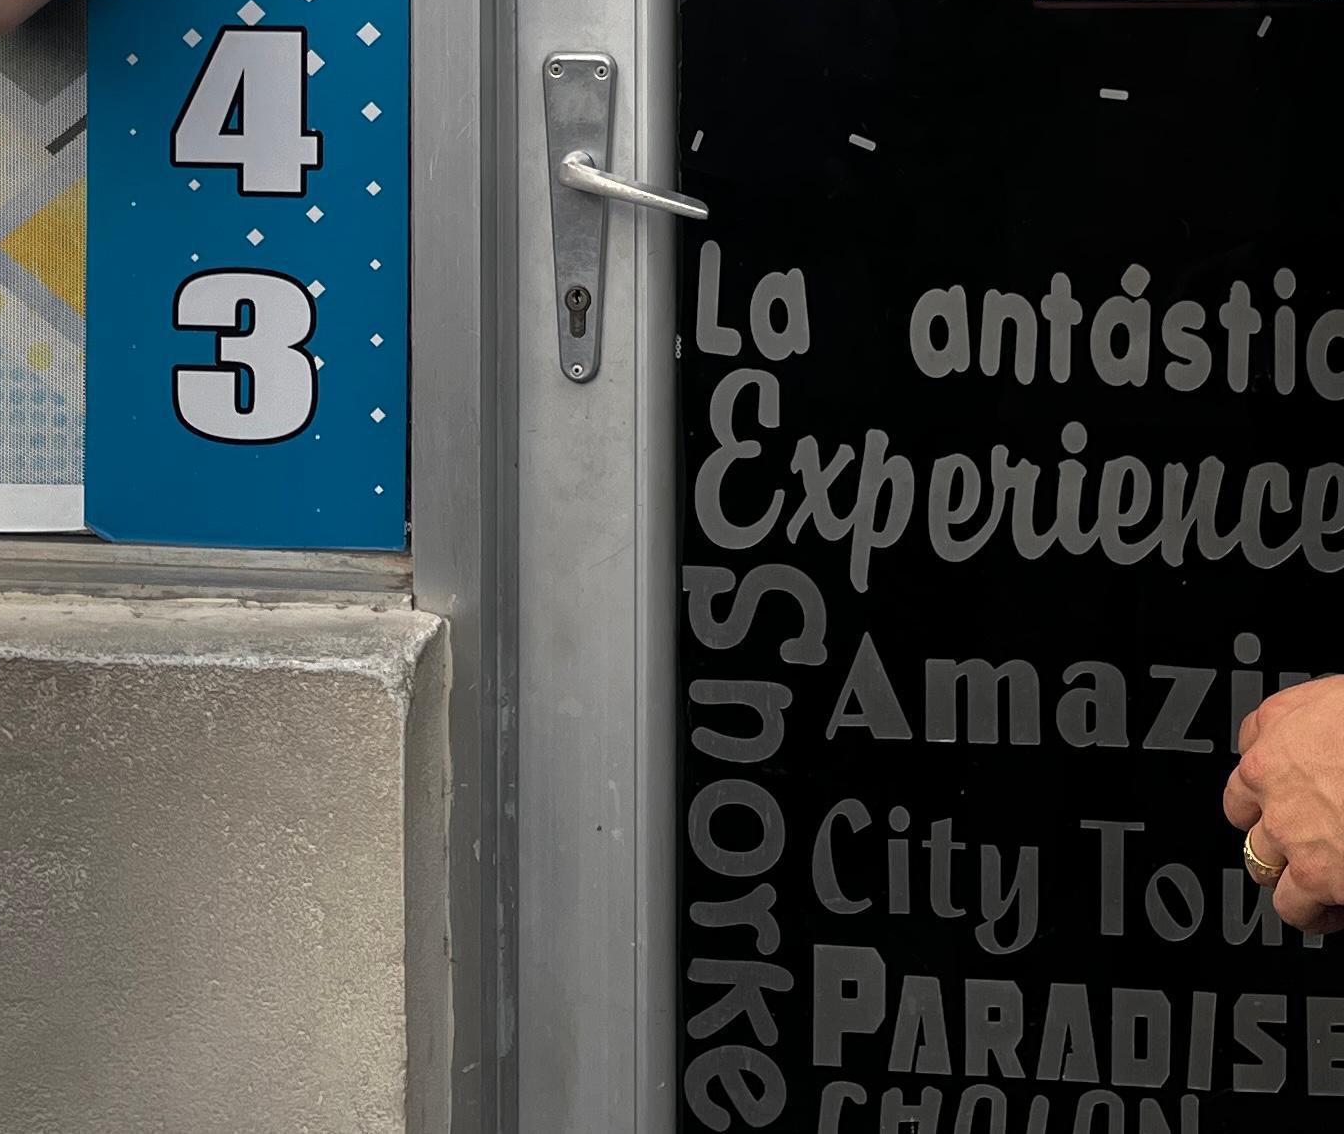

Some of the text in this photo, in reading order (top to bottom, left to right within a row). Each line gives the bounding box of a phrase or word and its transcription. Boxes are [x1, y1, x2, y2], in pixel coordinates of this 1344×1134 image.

[696, 240, 810, 361] La
[826, 632, 1311, 754] Amazi
[812, 798, 1324, 954] City Tou
